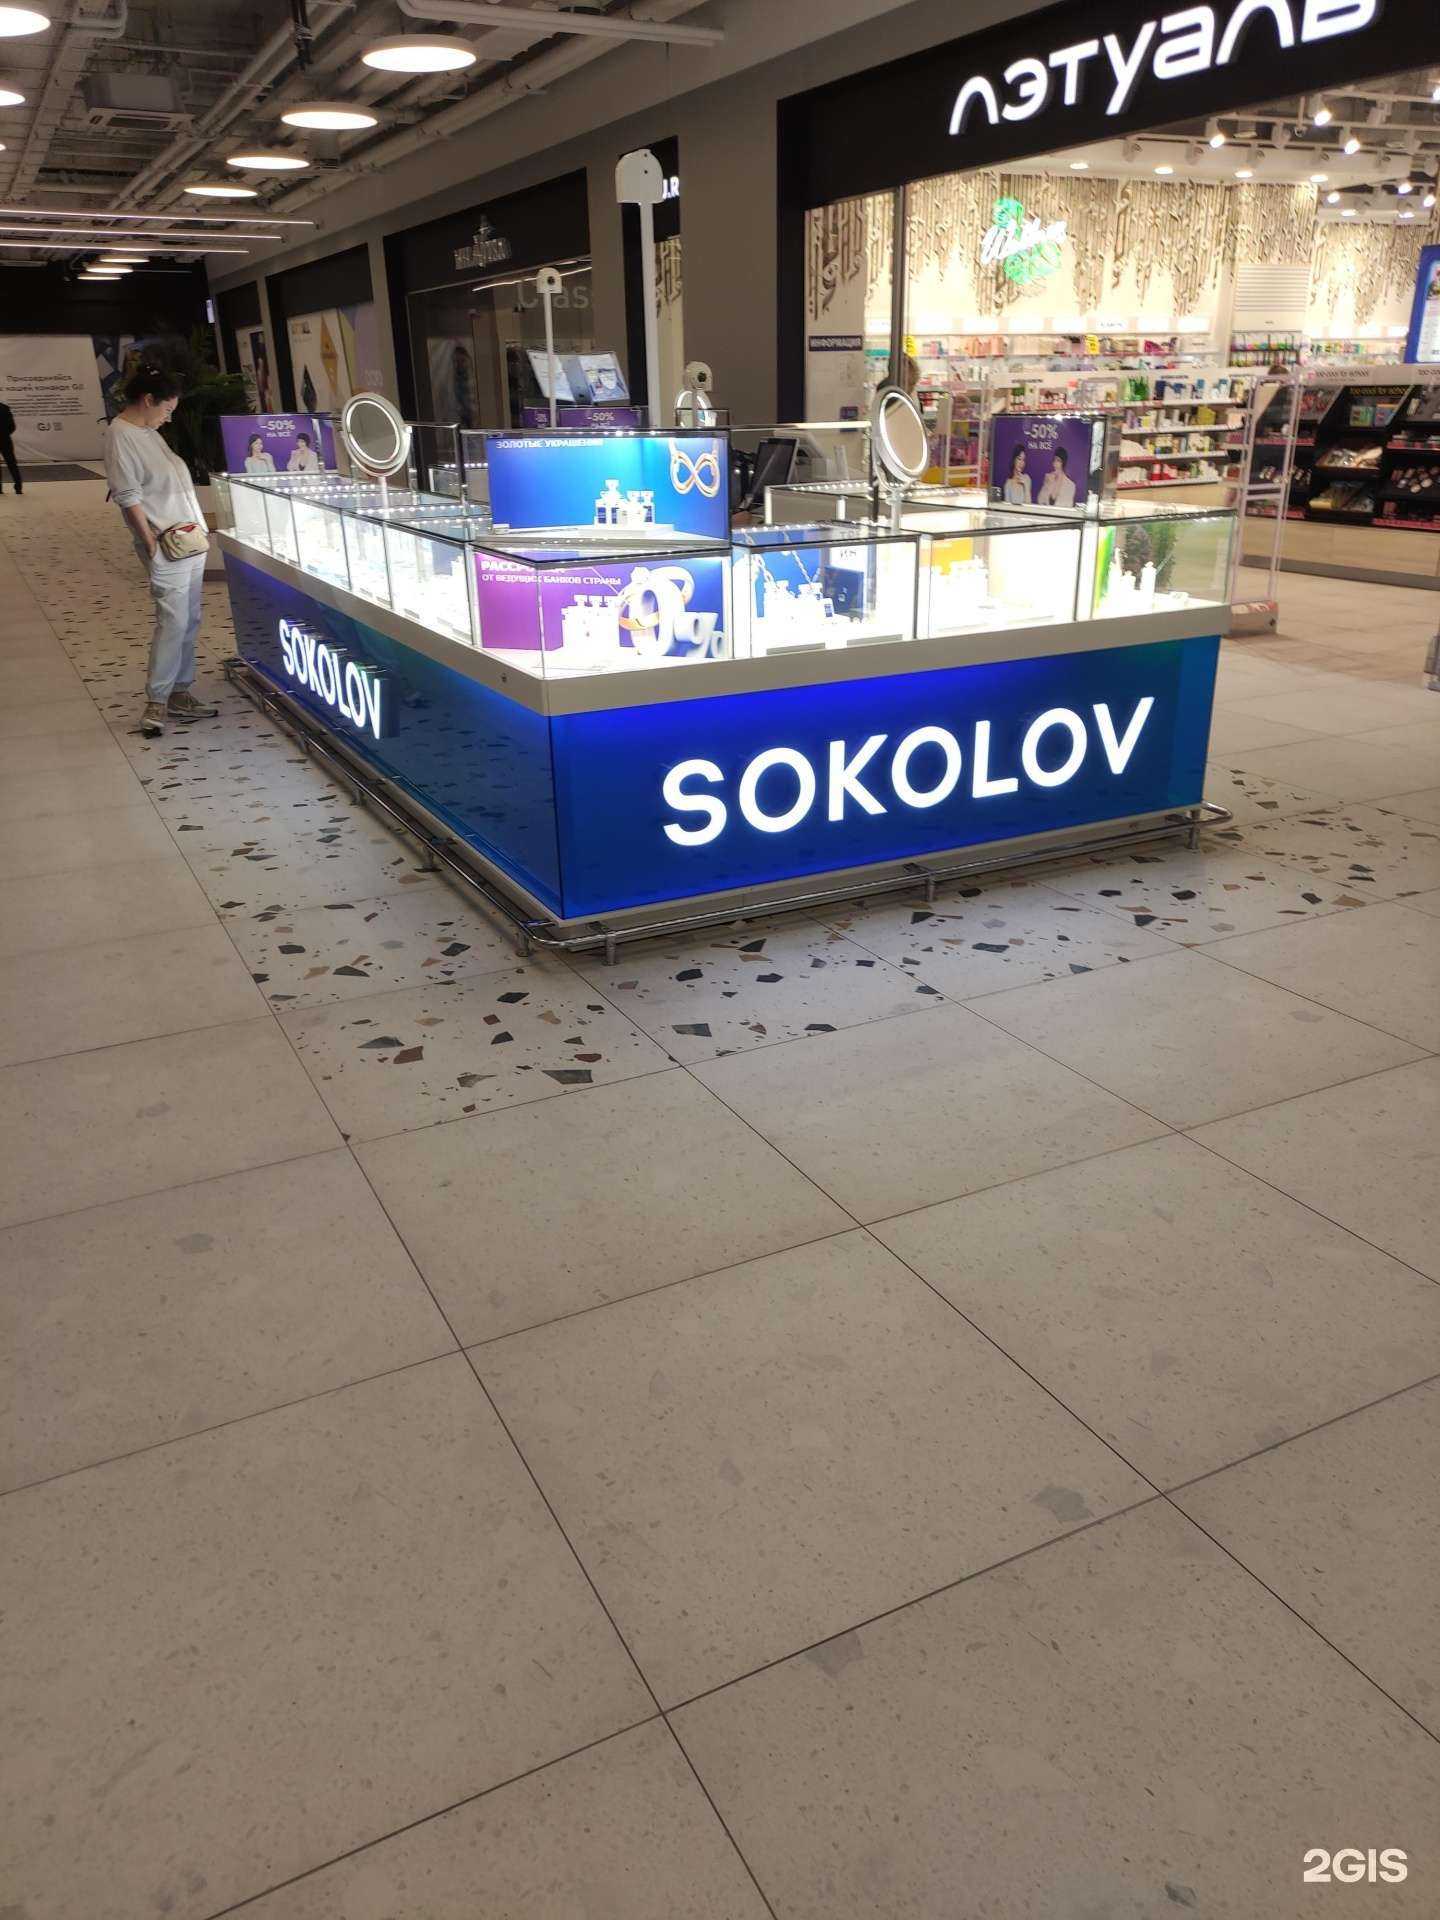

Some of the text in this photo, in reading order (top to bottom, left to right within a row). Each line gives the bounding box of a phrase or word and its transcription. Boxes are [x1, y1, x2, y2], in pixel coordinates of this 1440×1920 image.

[260, 419, 296, 431] -50%
[588, 412, 615, 421] -50%
[1024, 423, 1059, 440] -50%
[279, 618, 381, 740] SOKOLOV
[662, 696, 1156, 847] SOKOLOV
